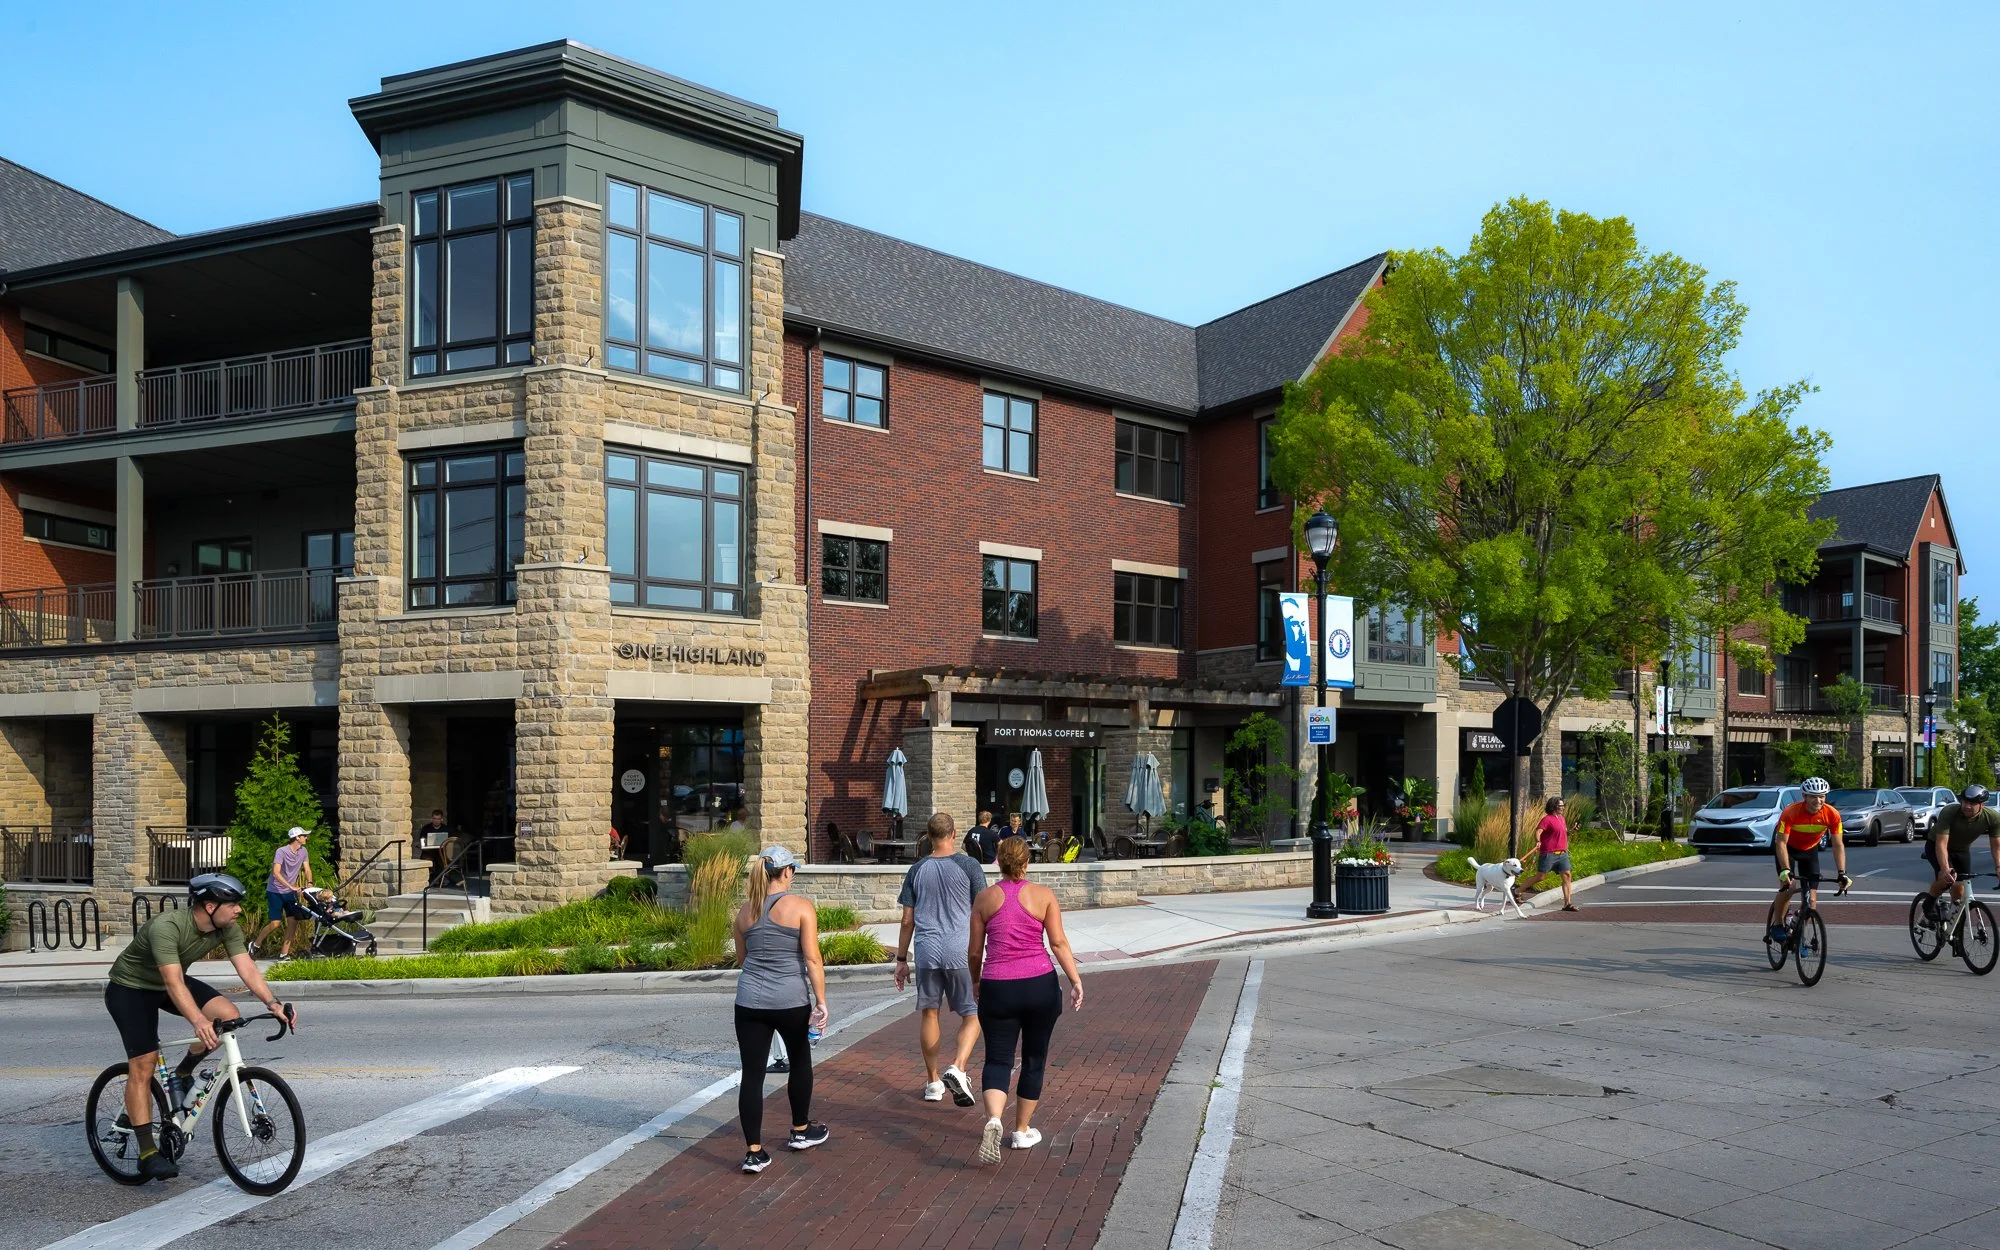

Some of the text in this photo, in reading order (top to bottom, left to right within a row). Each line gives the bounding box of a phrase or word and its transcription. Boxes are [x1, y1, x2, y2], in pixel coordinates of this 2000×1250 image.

[619, 642, 767, 667] ONE HIGHLAND
[994, 728, 1085, 738] FORT THOMAS COFFEE
